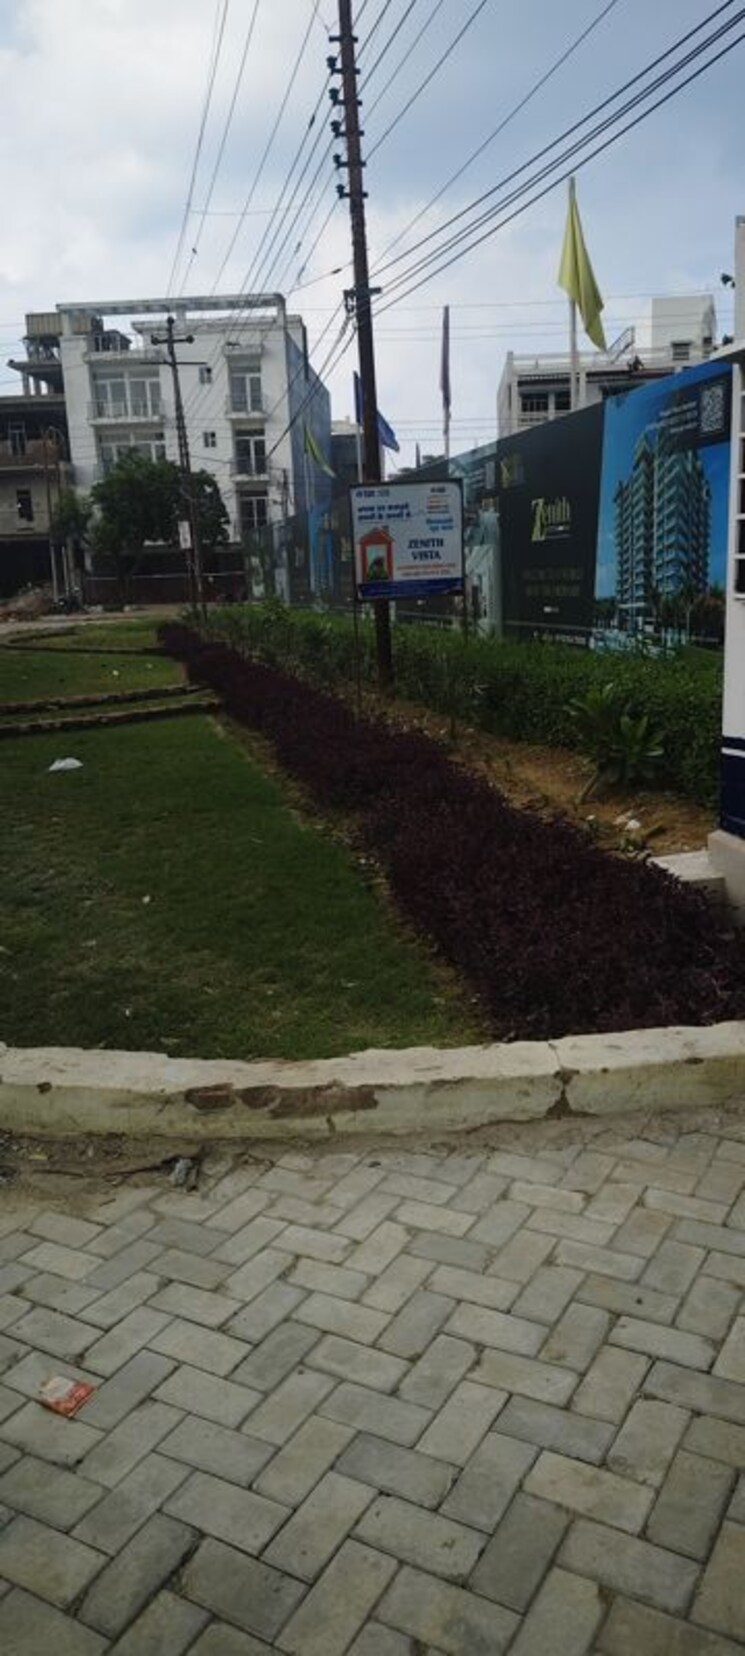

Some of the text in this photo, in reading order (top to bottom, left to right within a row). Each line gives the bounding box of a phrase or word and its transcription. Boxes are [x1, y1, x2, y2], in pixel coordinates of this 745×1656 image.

[531, 496, 571, 541] Zenith
[407, 537, 444, 549] ZENITH
[411, 550, 442, 561] VISTA
